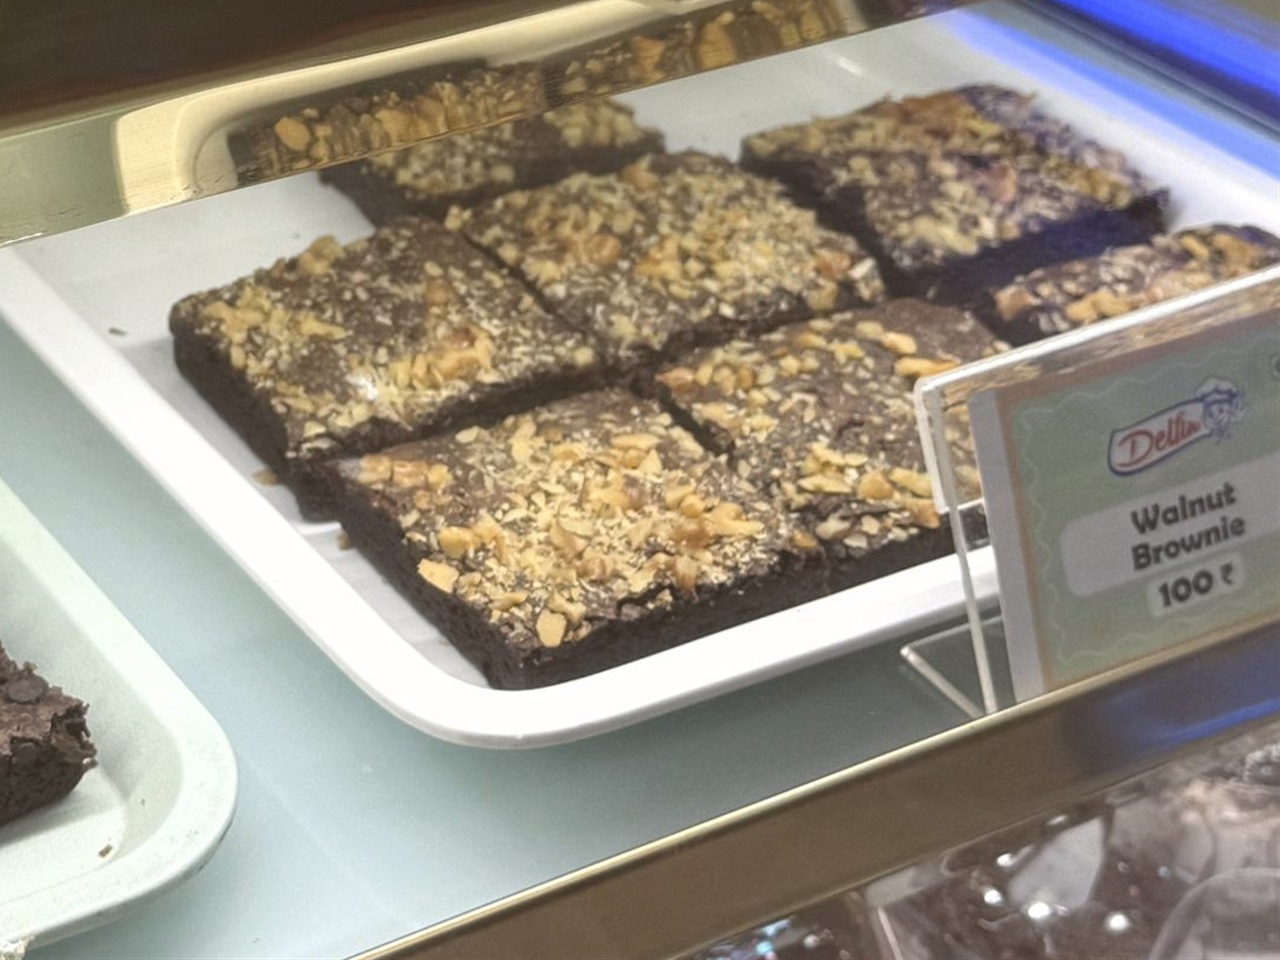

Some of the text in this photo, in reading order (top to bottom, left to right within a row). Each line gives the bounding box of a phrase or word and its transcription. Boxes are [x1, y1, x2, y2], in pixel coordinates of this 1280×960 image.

[1114, 411, 1201, 468] Delfin
[1130, 482, 1236, 534] Walnut
[1132, 516, 1245, 570] Brownie
[1158, 570, 1214, 608] 100
